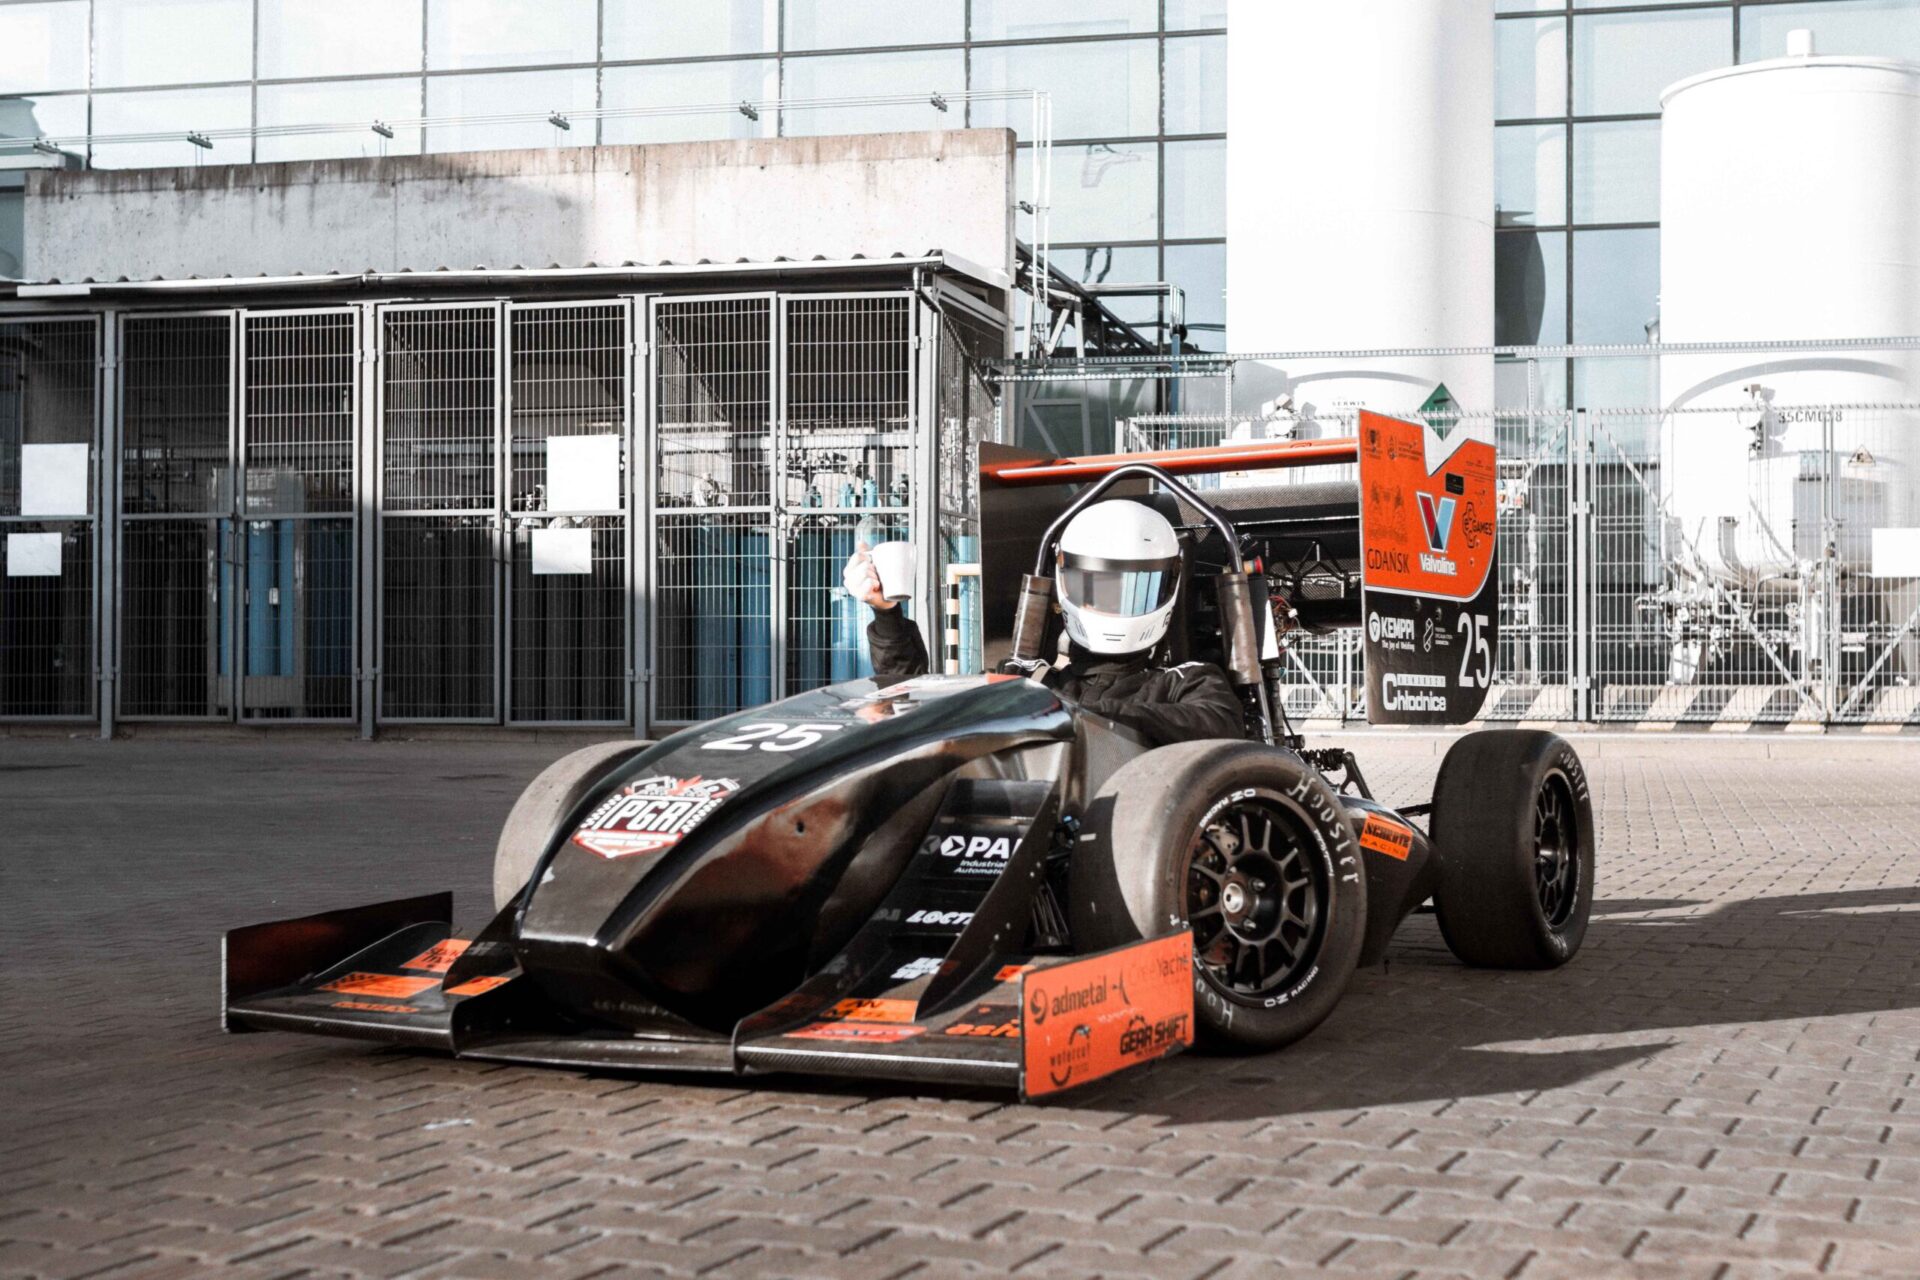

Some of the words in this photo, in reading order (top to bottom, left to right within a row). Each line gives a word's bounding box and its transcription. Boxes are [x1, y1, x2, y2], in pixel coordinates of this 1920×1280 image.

[1367, 548, 1410, 573] GDAŃSK
[1381, 617, 1415, 640] KEMPPI
[1457, 612, 1490, 689] 25
[700, 723, 844, 752] 25
[1052, 975, 1107, 1017] admetal
[1291, 966, 1320, 998] RACING
[1154, 1014, 1189, 1045] SHIFT
